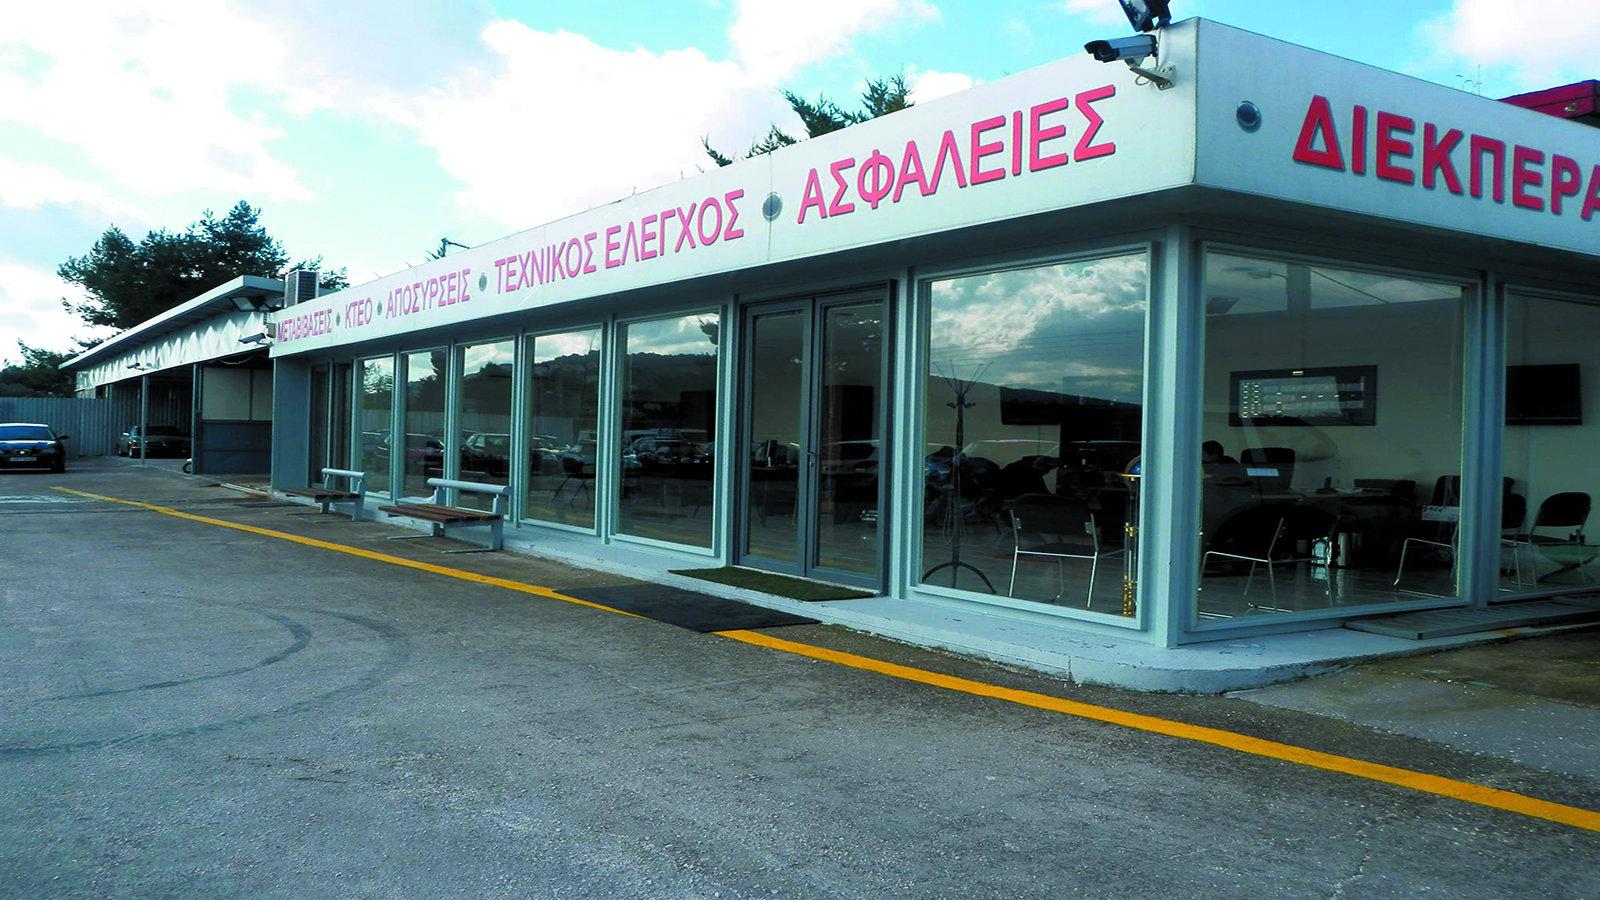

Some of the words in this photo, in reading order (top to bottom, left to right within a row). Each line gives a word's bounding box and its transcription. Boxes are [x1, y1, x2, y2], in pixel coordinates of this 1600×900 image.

[276, 308, 333, 343] ΜΕΤΑΒΙΒΑΣΕΙΣ
[345, 297, 373, 329] ΚΤΕΟ
[385, 268, 471, 320] ΑΠΟΣΥΡΣΕΙΣ
[494, 232, 598, 295] ΤΕΧΝΙΚΟΣ
[604, 188, 745, 270] ΕΛΕΓΧΟΣ
[796, 84, 1117, 225] ΑΣΦΑΛΕΙΕΣ
